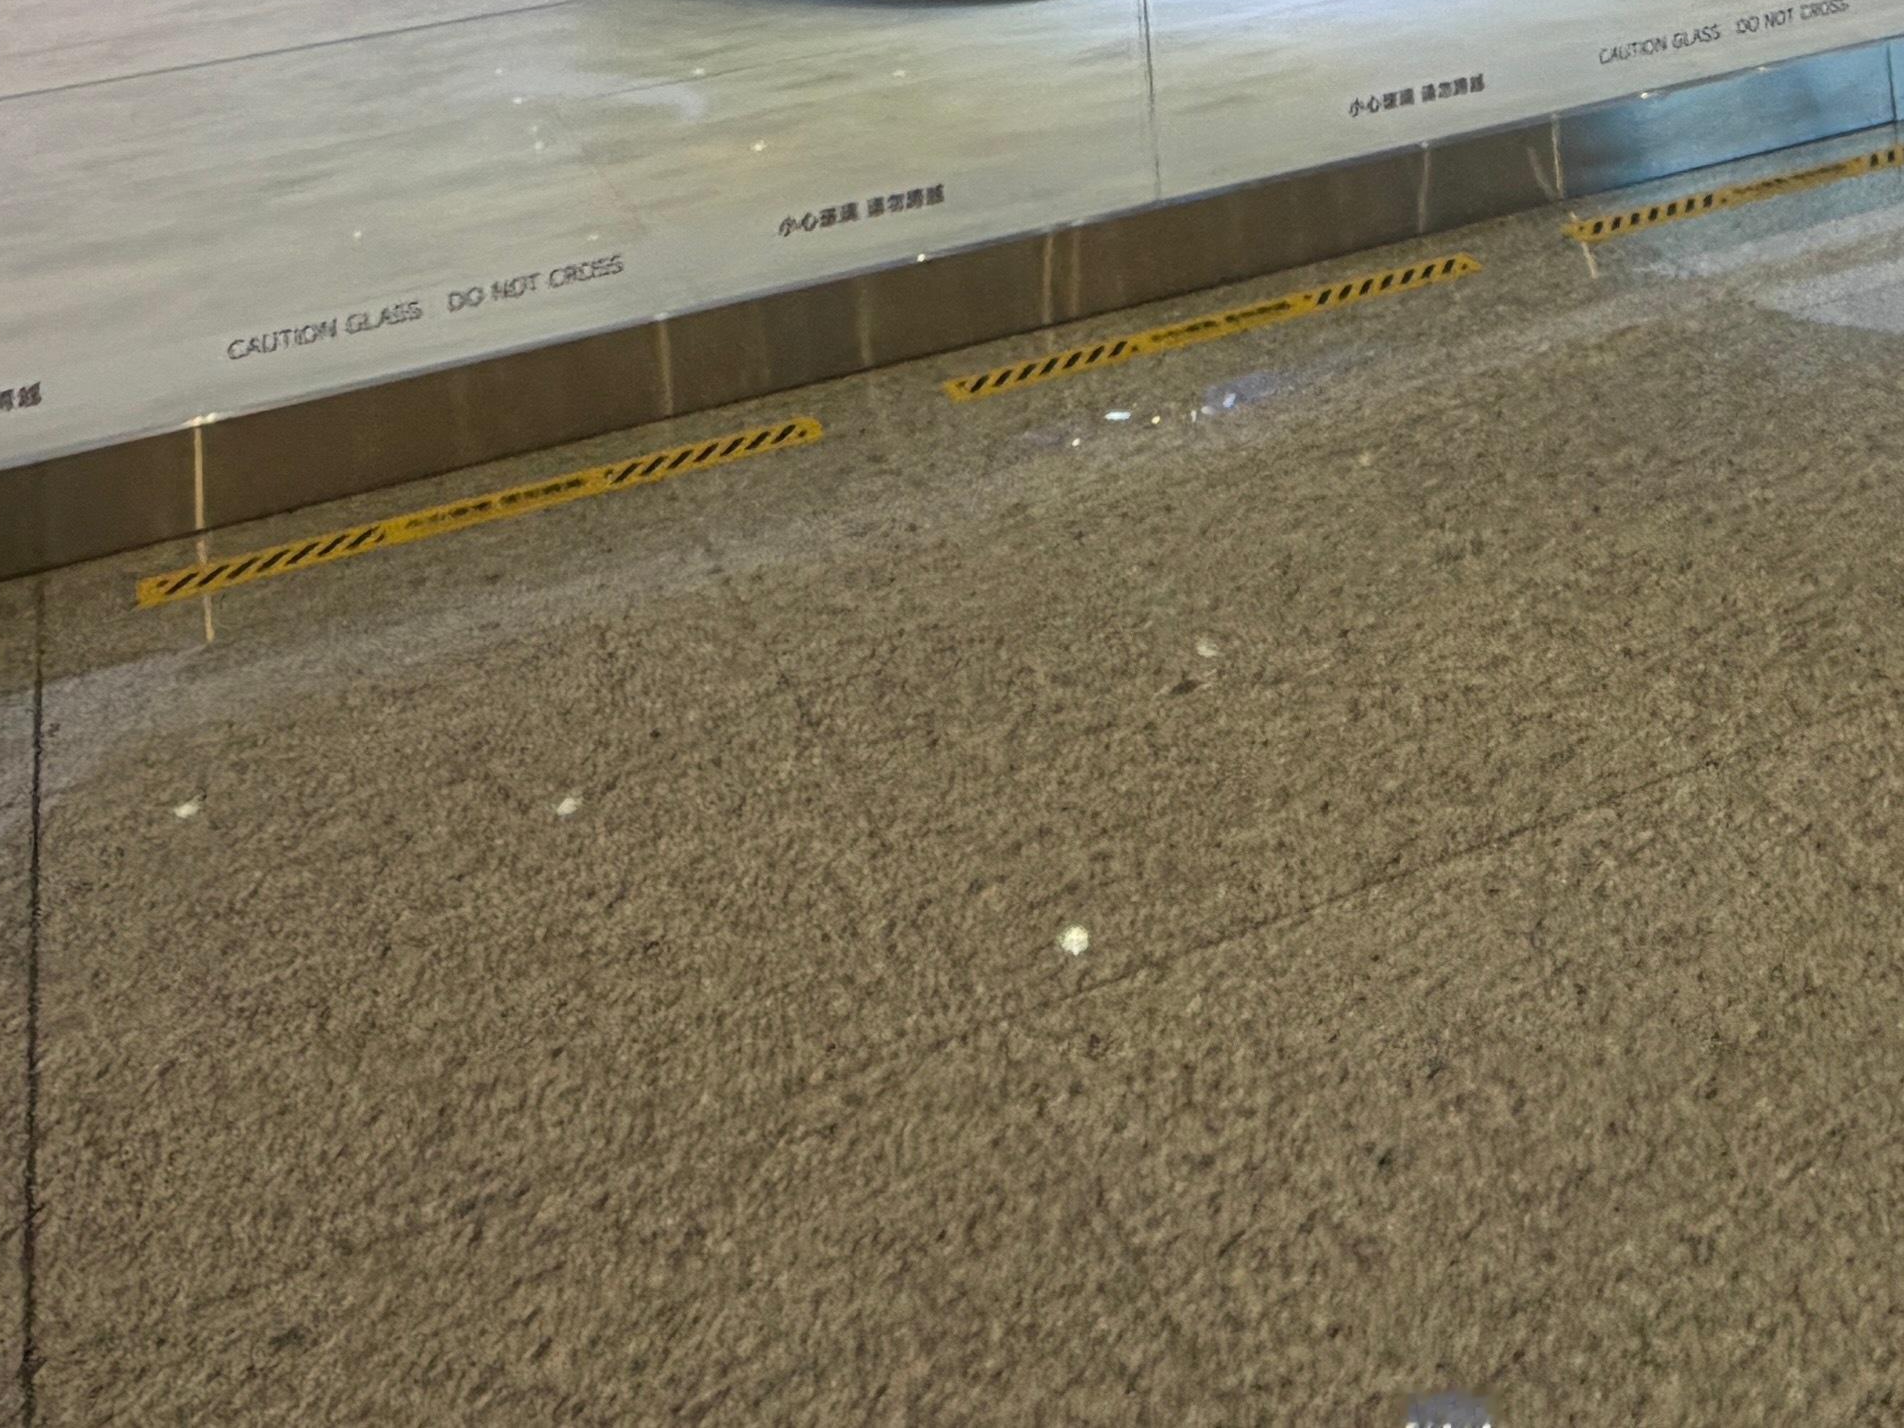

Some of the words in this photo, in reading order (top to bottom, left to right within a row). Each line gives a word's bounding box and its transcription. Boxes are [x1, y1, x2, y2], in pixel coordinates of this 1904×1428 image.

[1599, 37, 1668, 64] CAUTION
[1671, 24, 1721, 49] GLASS
[1736, 16, 1759, 34] DO
[1764, 7, 1794, 29] NOT
[227, 318, 337, 361] CAUTION
[345, 301, 424, 335] GLASS
[447, 287, 485, 313] DO
[492, 272, 541, 301] NOT
[548, 253, 624, 290] CROSS
